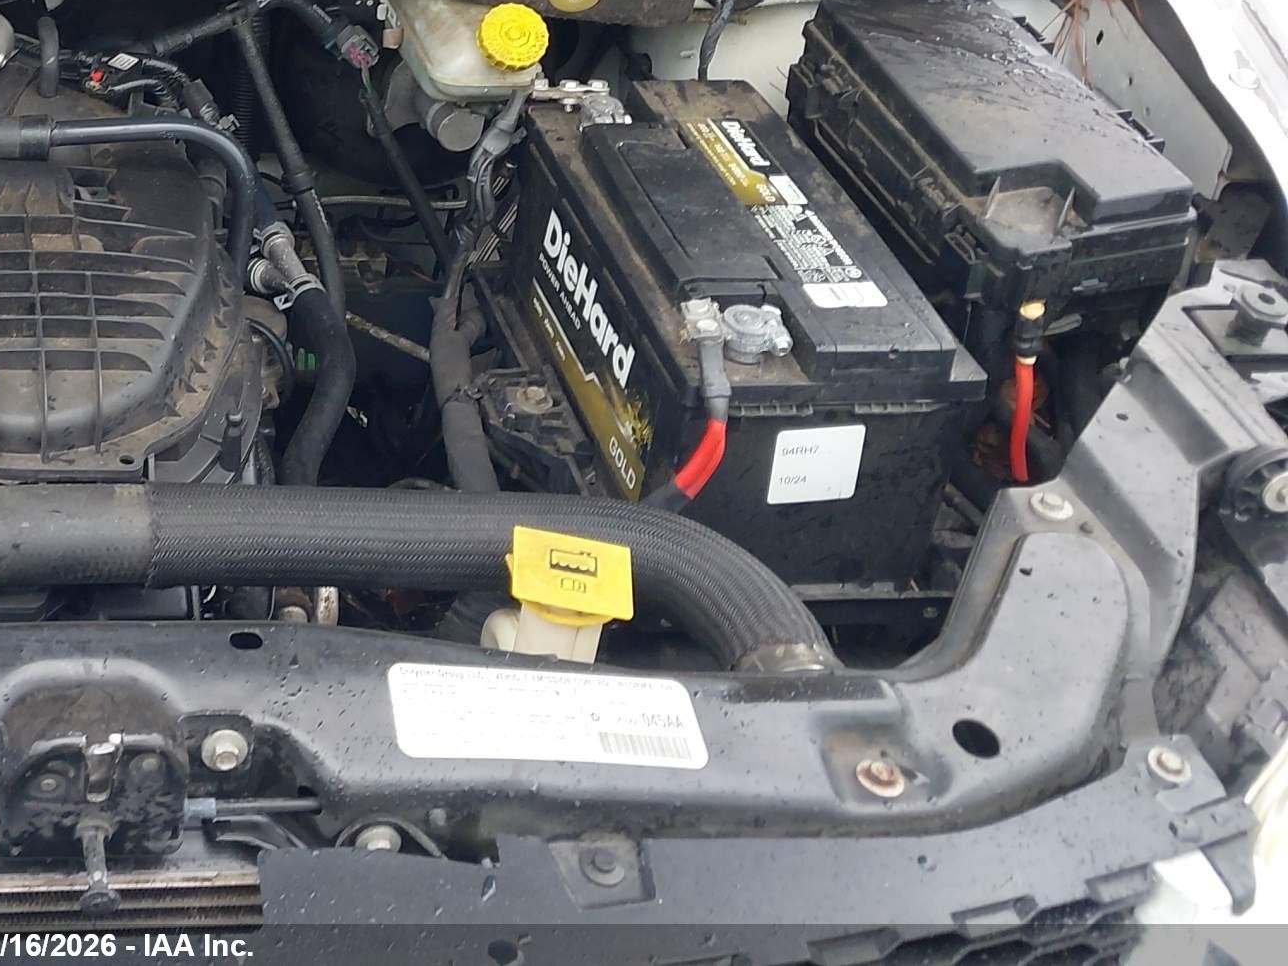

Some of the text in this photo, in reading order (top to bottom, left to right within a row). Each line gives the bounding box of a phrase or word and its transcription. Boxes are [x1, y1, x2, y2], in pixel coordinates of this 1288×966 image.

[721, 121, 771, 166] DieHard
[539, 252, 560, 293] POWER
[559, 291, 582, 331] AHEAD
[543, 207, 637, 389] DieHard
[608, 436, 637, 490] GOLD
[779, 475, 807, 484] 10/24
